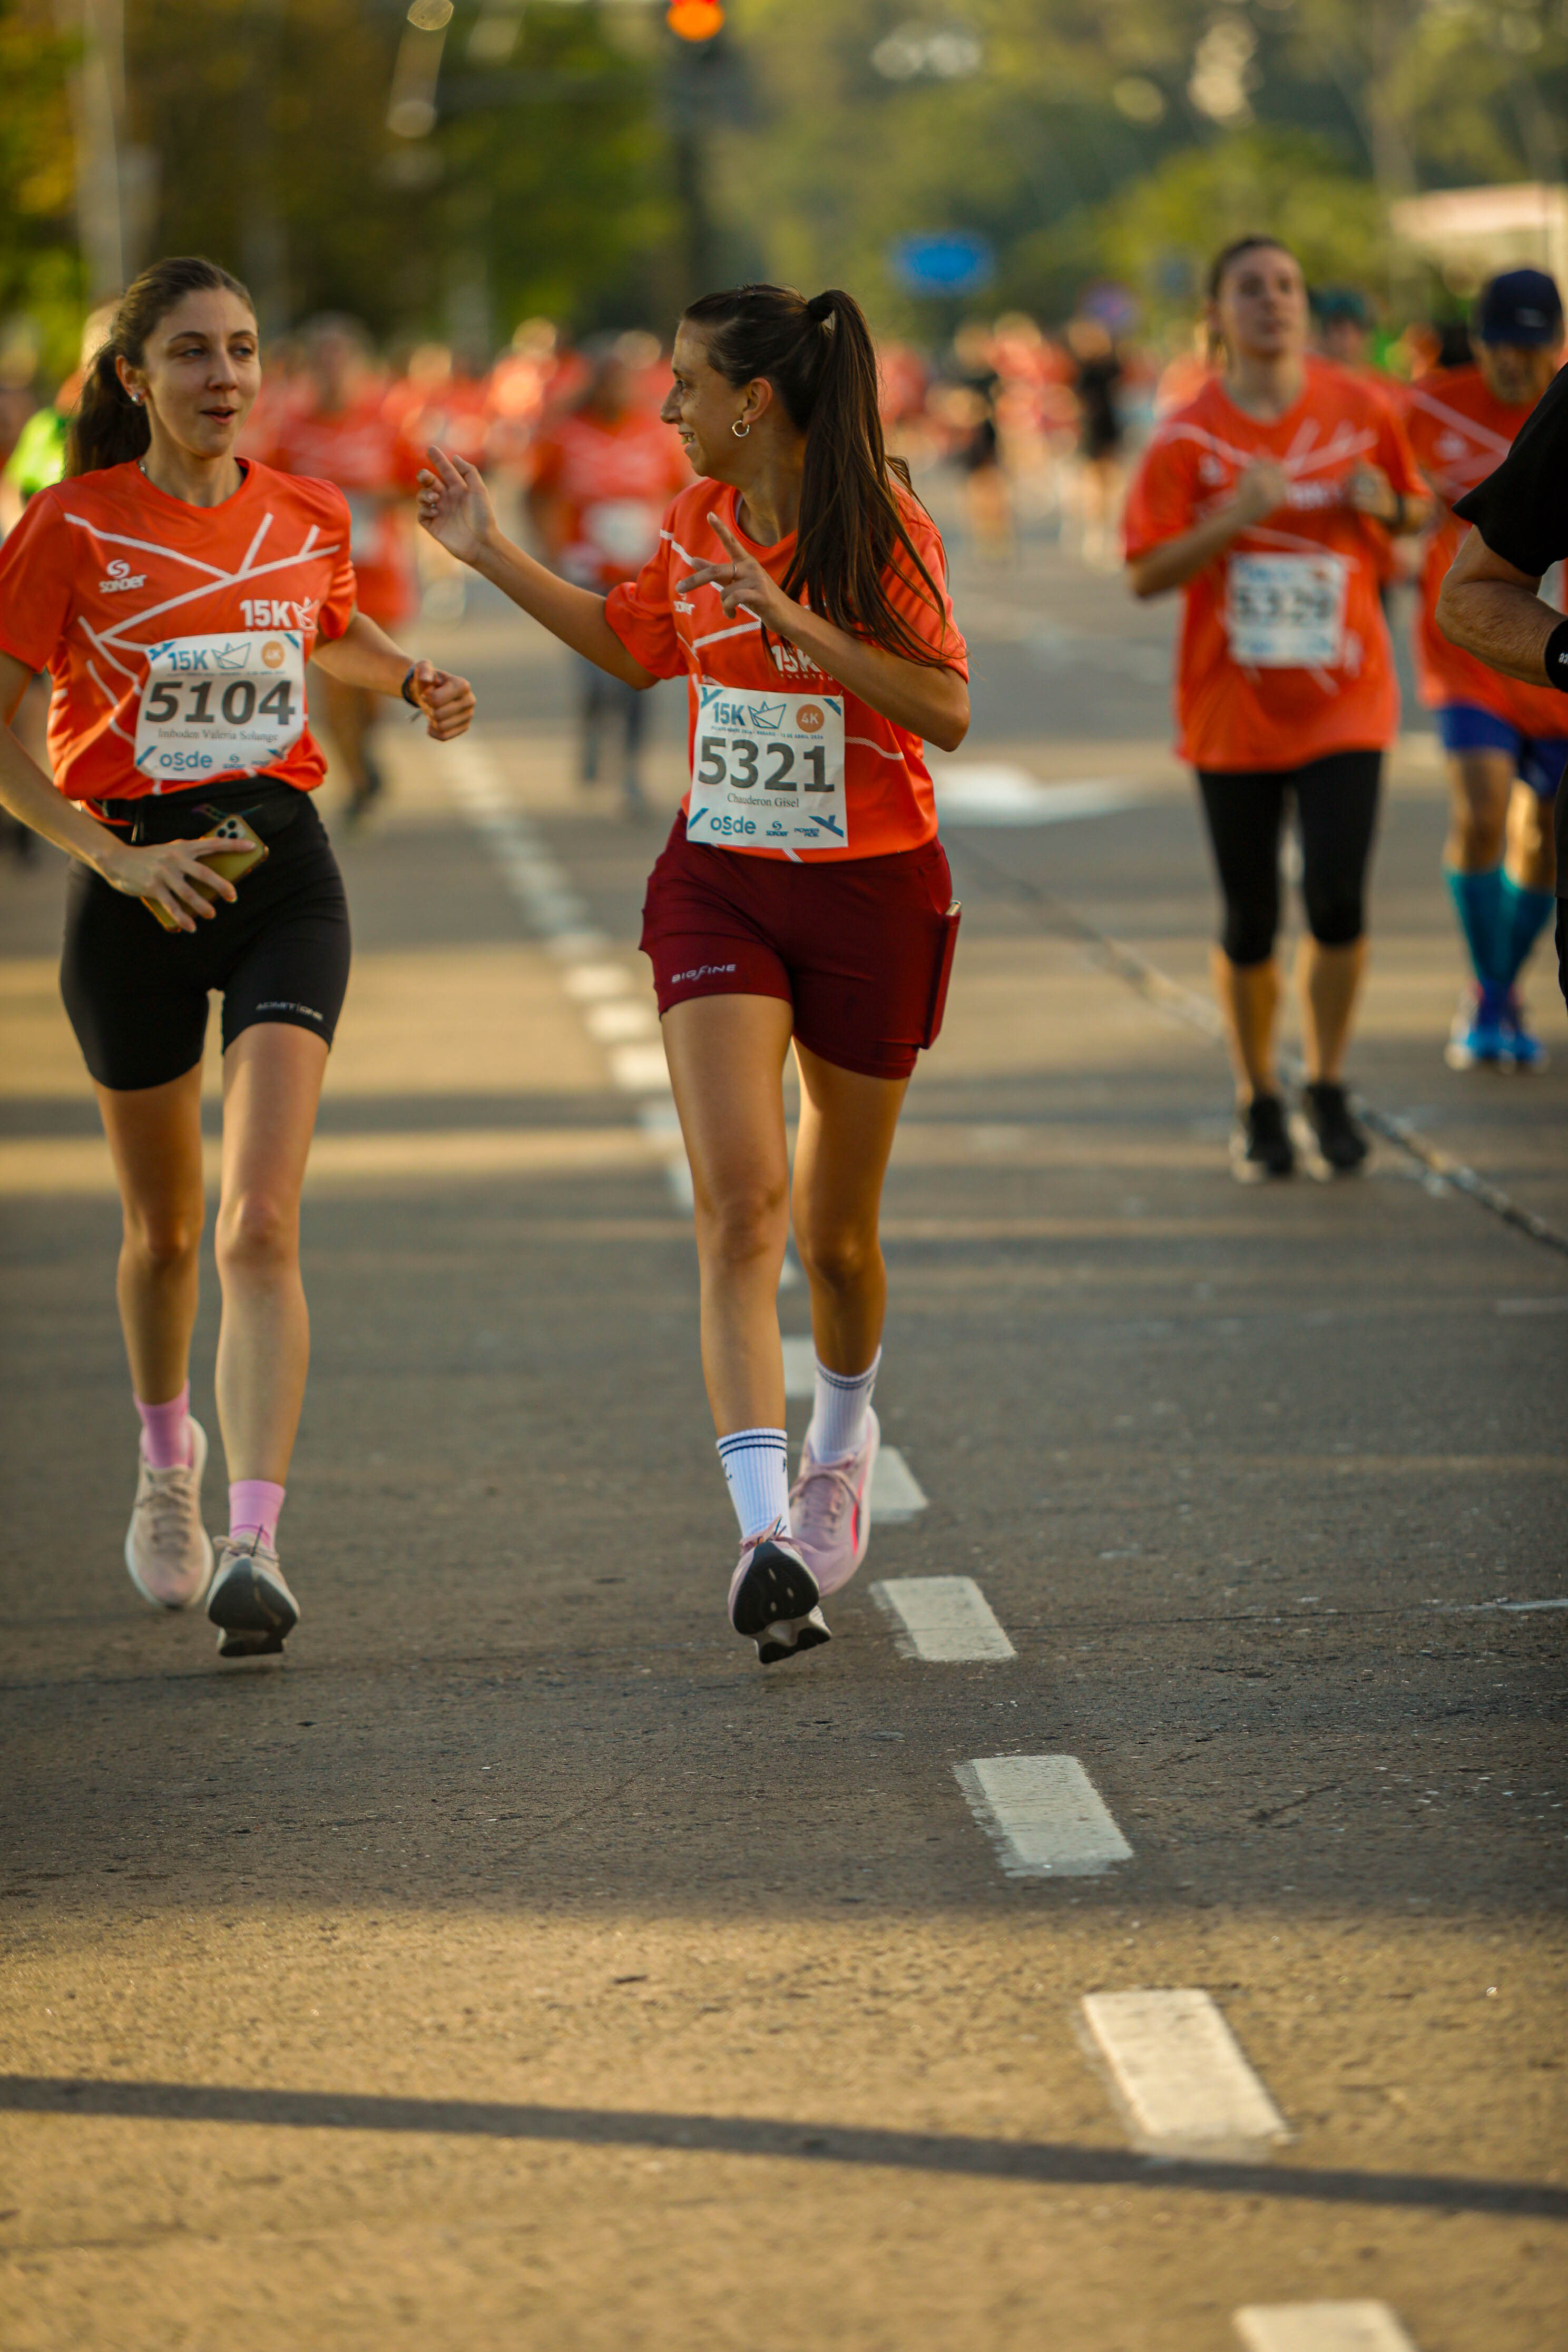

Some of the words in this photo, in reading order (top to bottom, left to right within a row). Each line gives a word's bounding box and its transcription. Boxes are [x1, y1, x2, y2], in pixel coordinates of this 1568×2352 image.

[240, 599, 292, 628] 15K
[168, 649, 209, 671] 15K
[145, 680, 296, 725] 5104
[712, 701, 746, 726] 15K
[800, 712, 819, 724] 4K
[160, 750, 212, 771] osde
[698, 736, 835, 792] 5321
[727, 792, 772, 806] Chauderon
[775, 797, 799, 808] Gisel
[710, 816, 756, 836] osde
